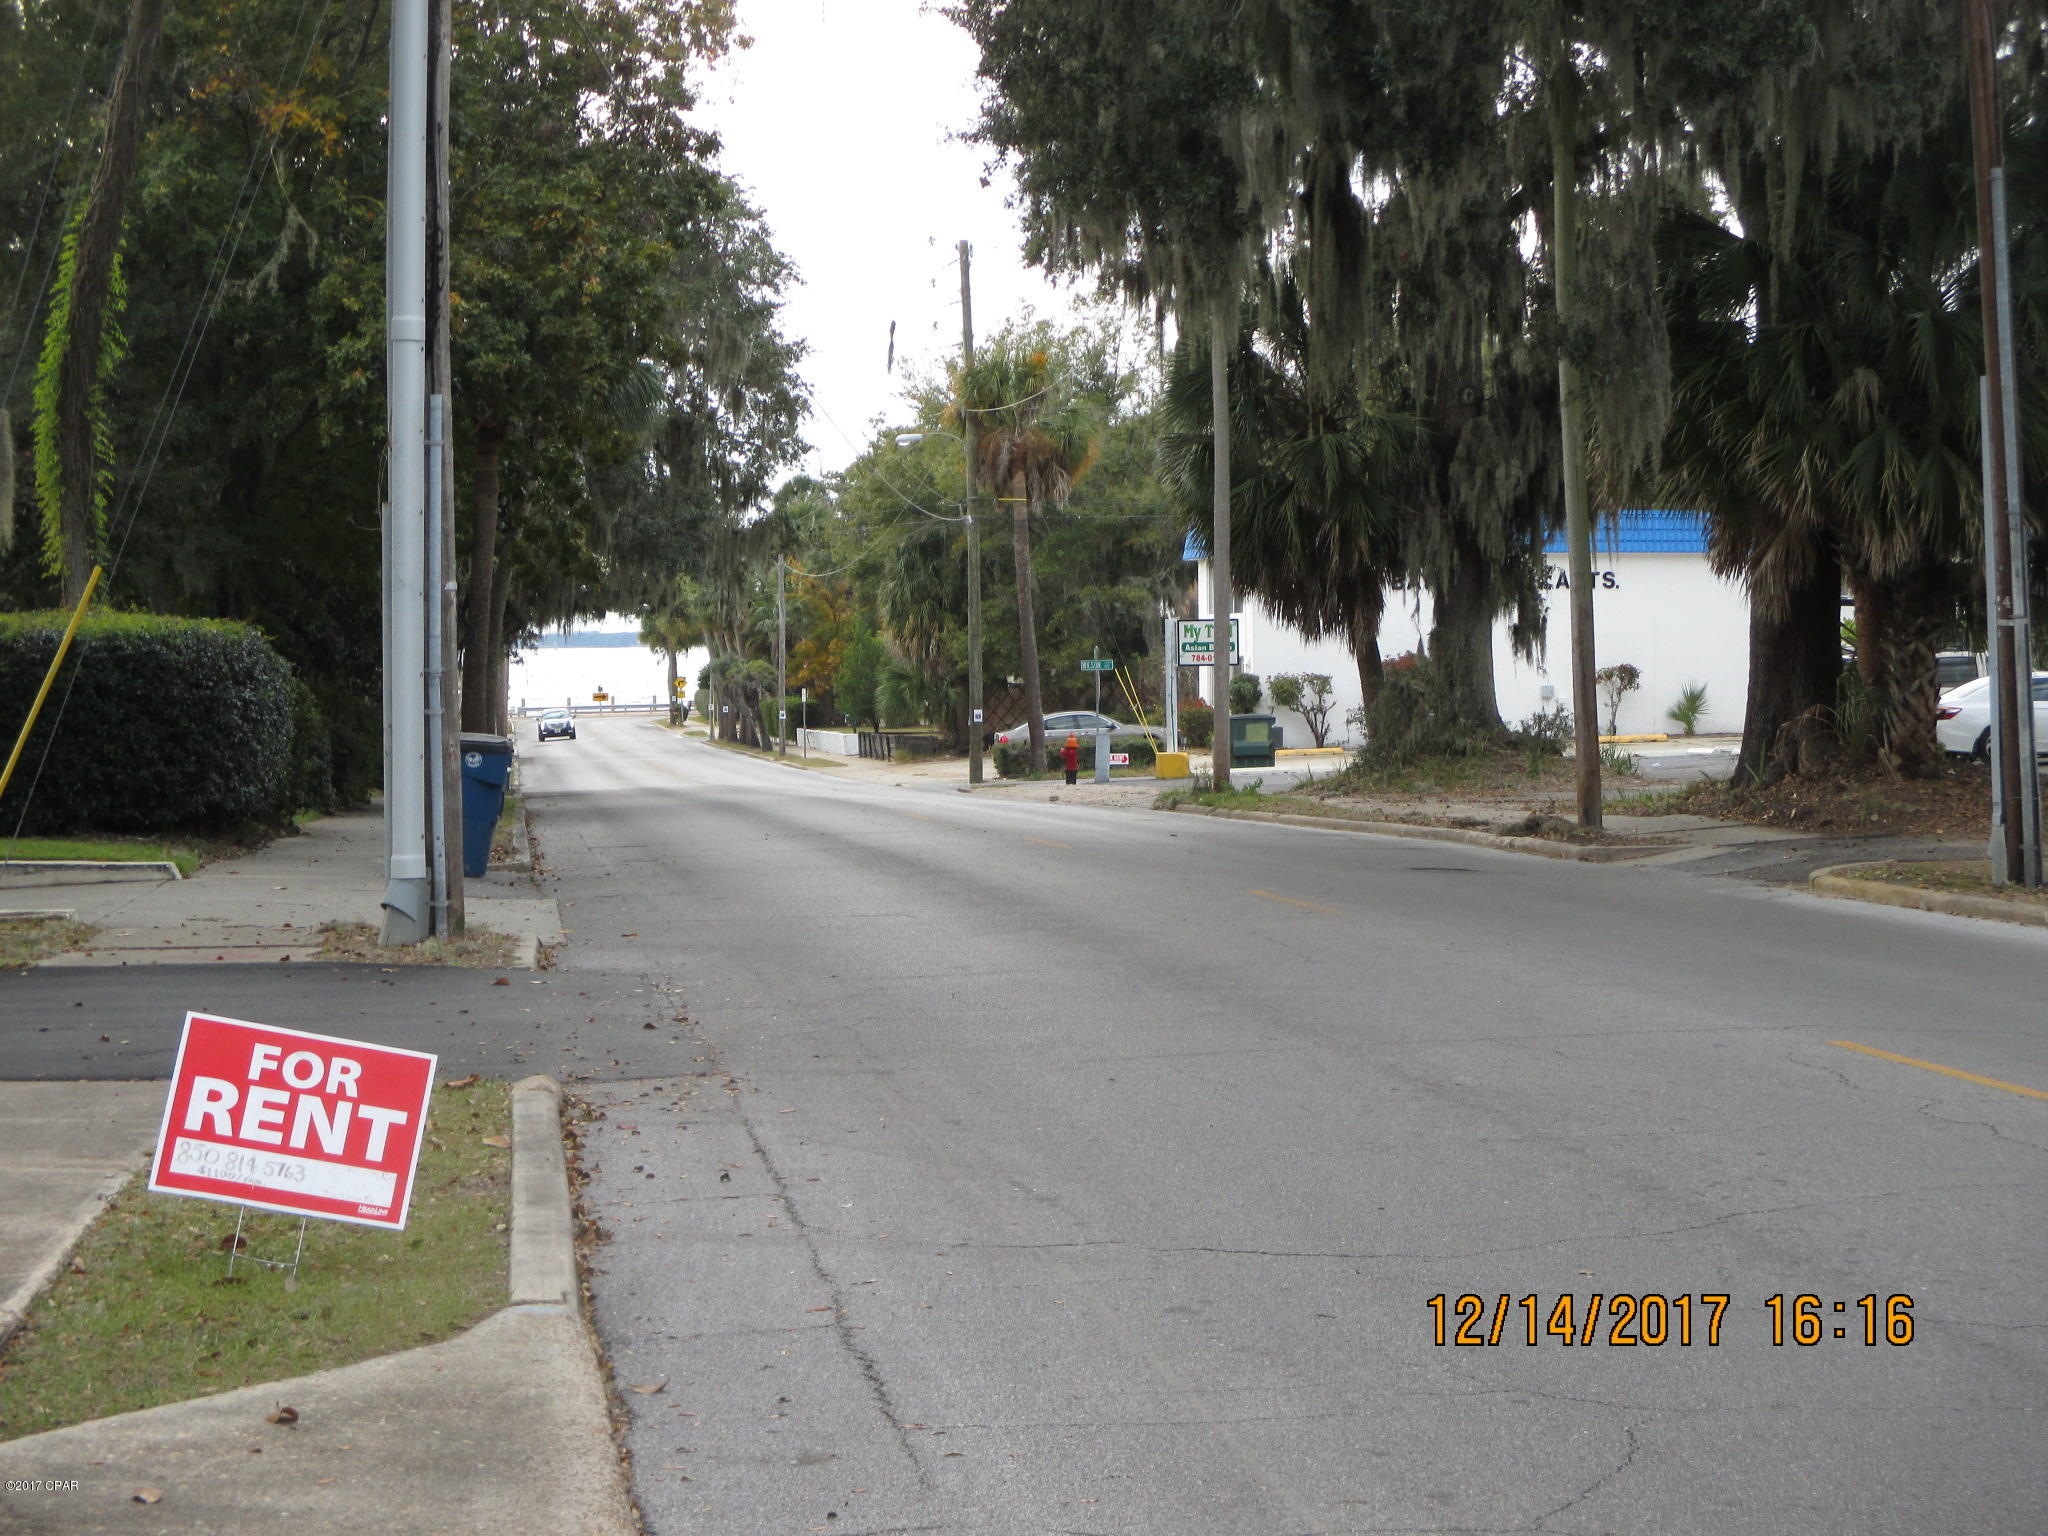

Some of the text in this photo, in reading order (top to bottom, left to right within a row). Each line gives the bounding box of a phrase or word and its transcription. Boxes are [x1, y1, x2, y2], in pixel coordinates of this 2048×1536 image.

[1184, 624, 1201, 641] My
[248, 1043, 362, 1098] FOR
[184, 1076, 408, 1162] RENT
[177, 1140, 220, 1164] 850
